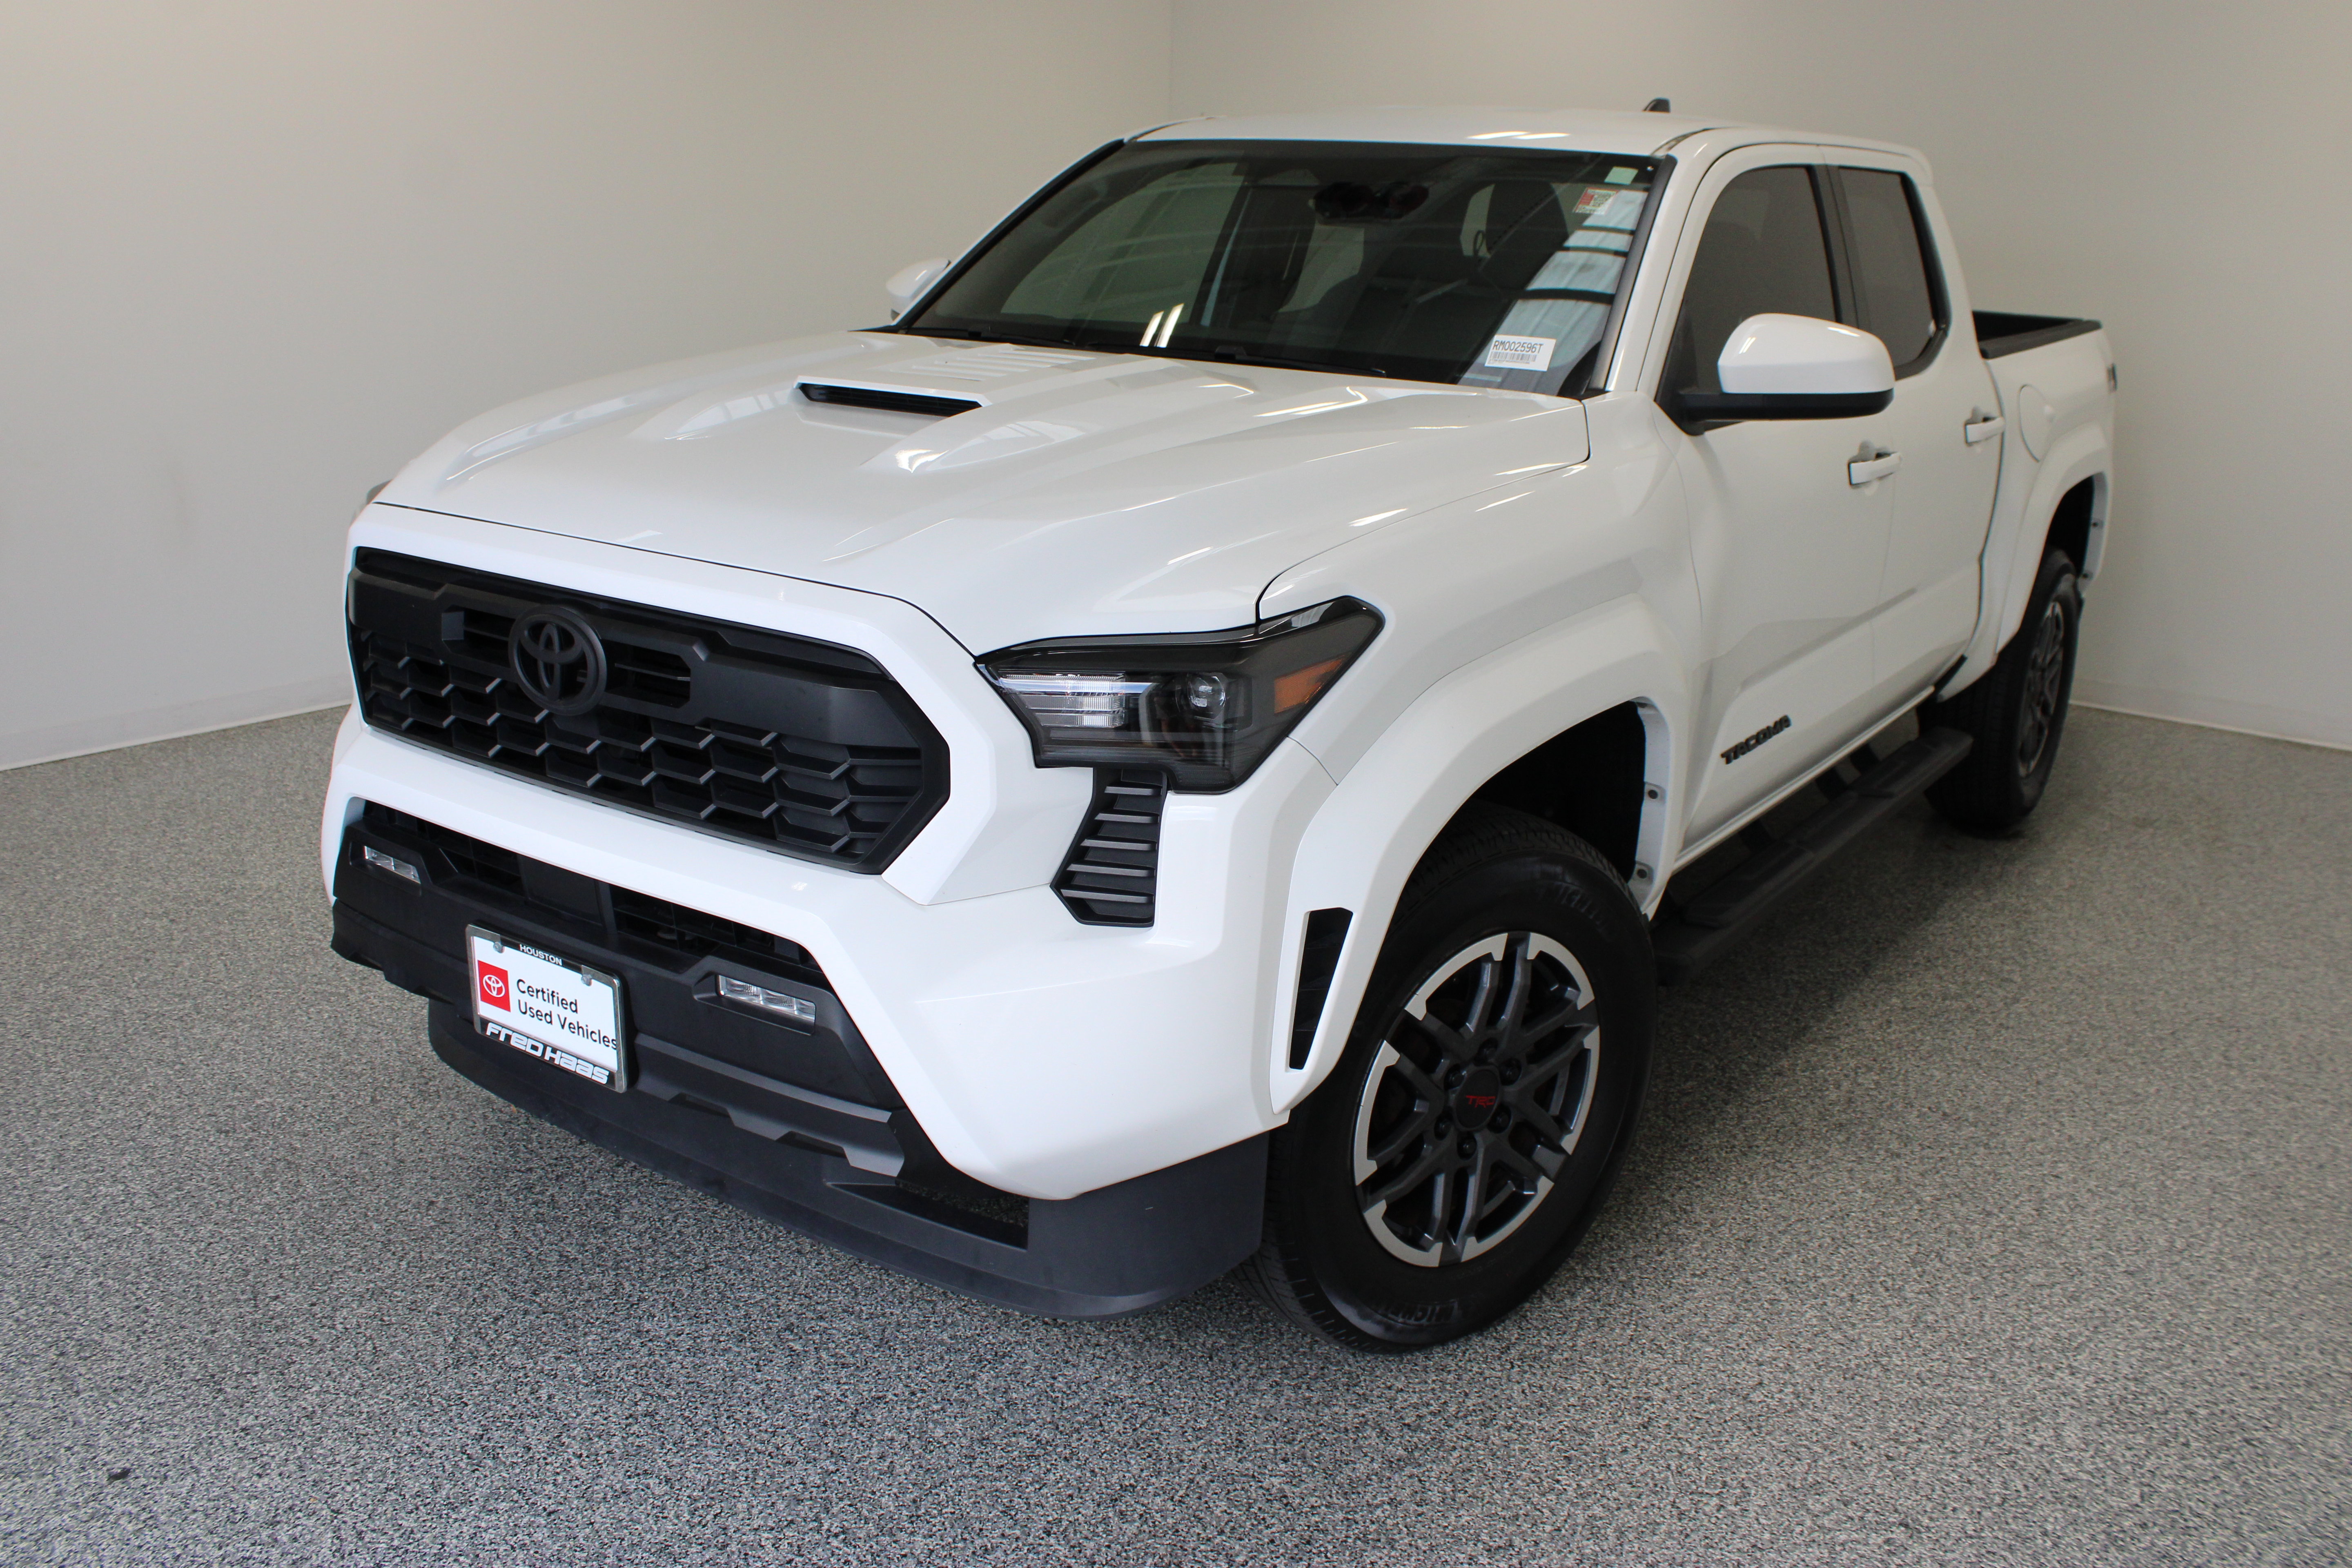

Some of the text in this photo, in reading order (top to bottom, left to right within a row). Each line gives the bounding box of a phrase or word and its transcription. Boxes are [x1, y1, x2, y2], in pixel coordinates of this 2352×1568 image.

[1492, 340, 1544, 353] RM002596T
[1720, 715, 1791, 764] TACOMA
[519, 944, 562, 966] HOUSTON
[517, 979, 578, 1013] Certified
[518, 999, 617, 1049] Used Vehicles
[1465, 1095, 1496, 1107] TRD
